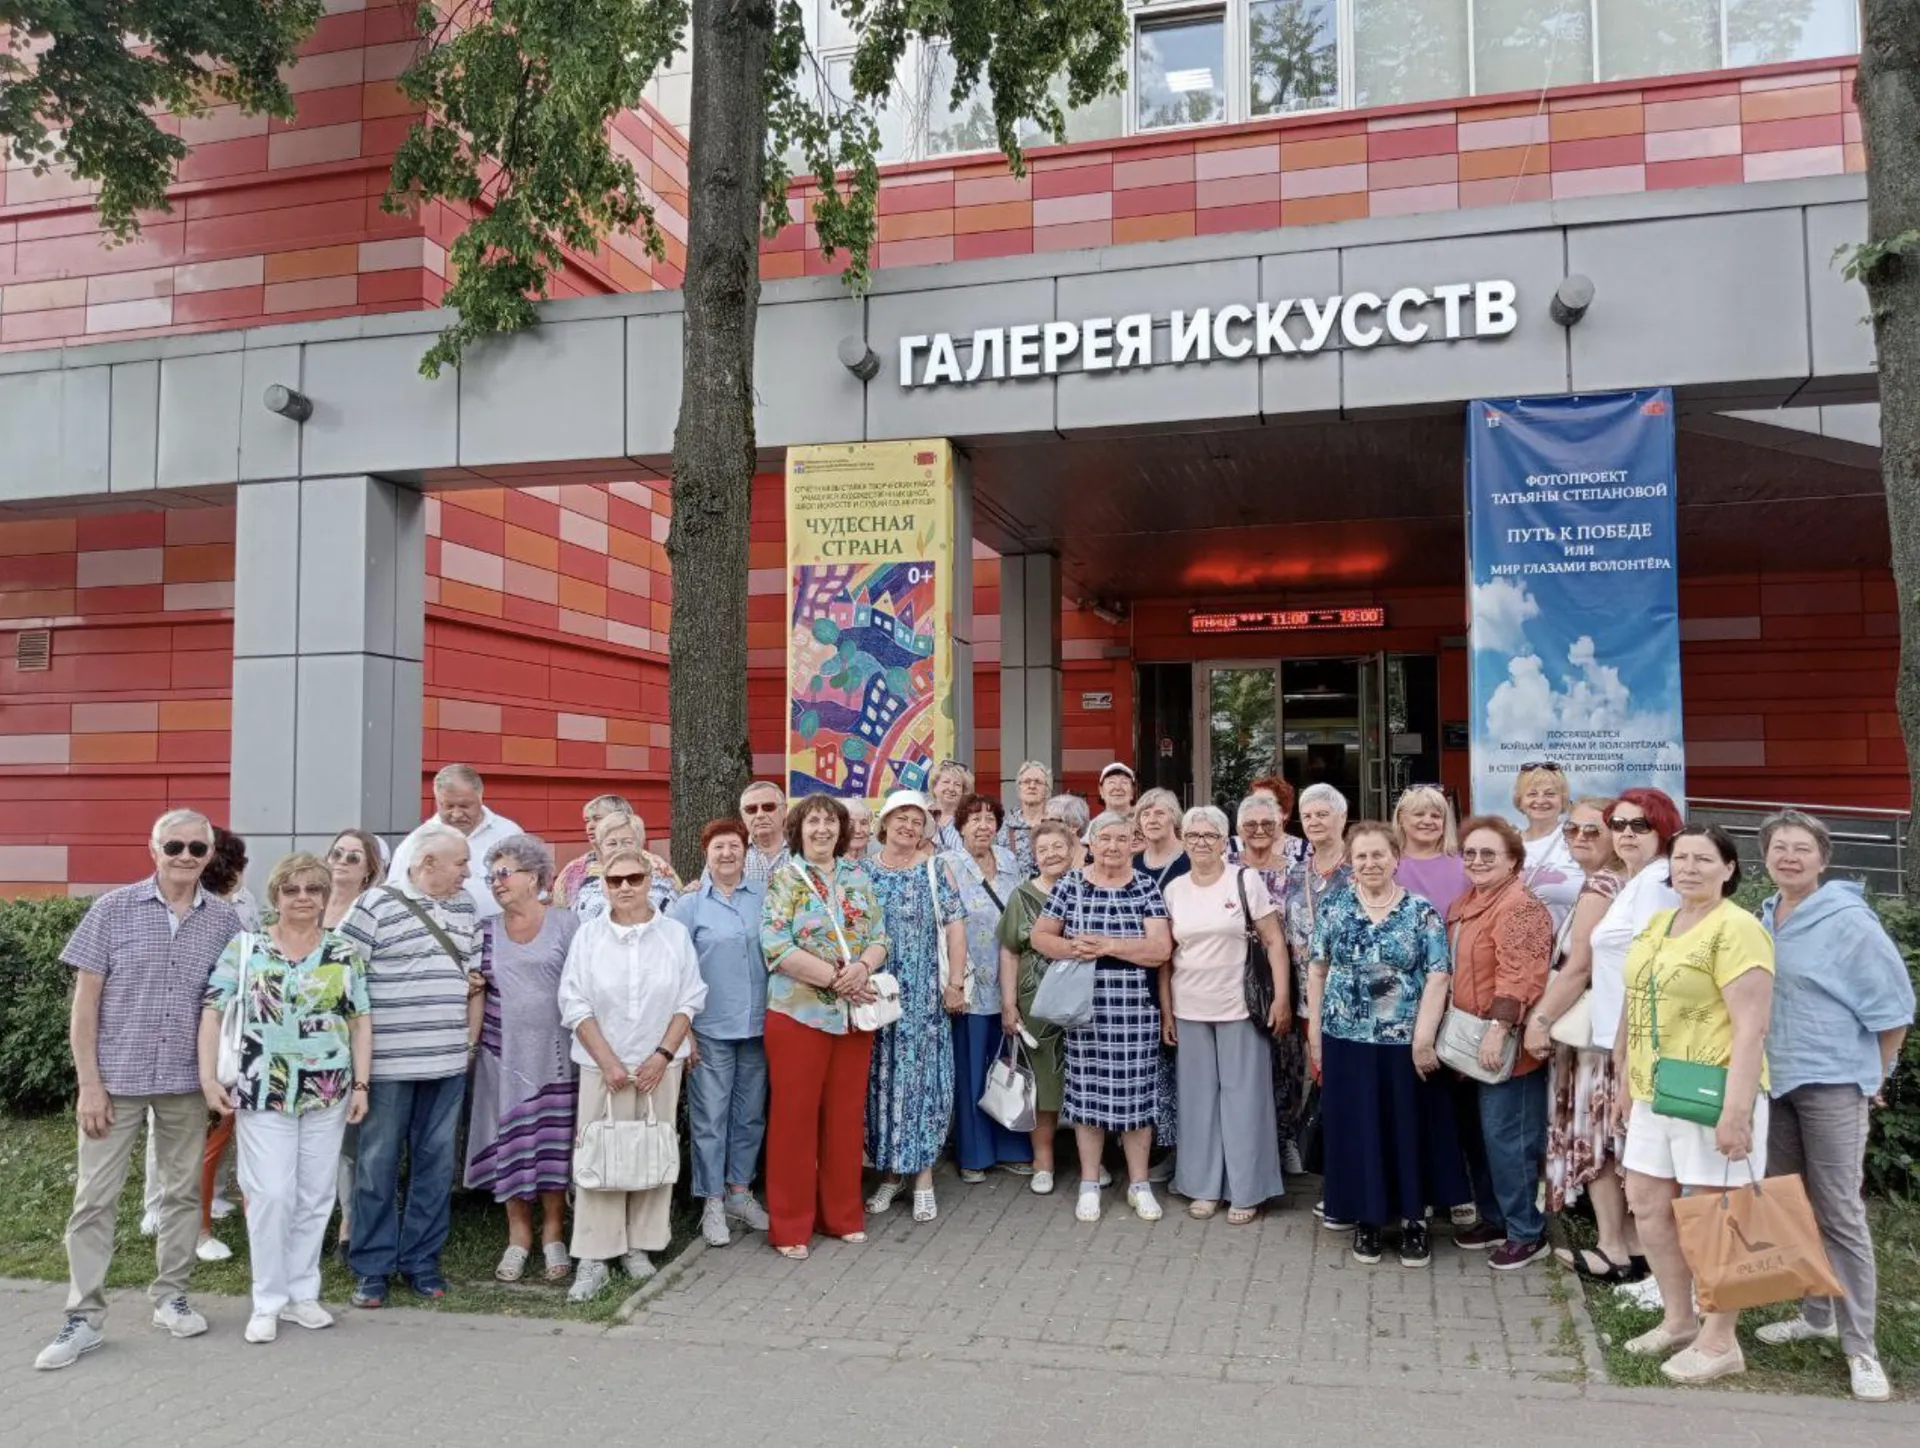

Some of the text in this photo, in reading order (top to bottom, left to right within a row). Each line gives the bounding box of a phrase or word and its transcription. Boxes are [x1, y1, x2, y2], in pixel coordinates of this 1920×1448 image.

[899, 278, 1518, 387] ГАЛЕРЕЯ ИСКУССТВ
[1526, 470, 1628, 487] ФОТОПРОЕКТ
[1491, 482, 1668, 505] ТАТЬЯНЫ СТЕПАНОВОЙ
[806, 514, 915, 538] ЧУДЕСНАЯ
[1507, 522, 1653, 544] ПУТЬ К ПОБЕДЕ
[822, 538, 904, 557] СТРАНА
[1563, 544, 1595, 557] ИЛИ
[1490, 556, 1672, 575] МИР ГЛАЗАМИ ВОЛОНТЁРА
[907, 567, 933, 584] 0+
[1271, 613, 1309, 626] 11:00
[1340, 608, 1378, 623] 19:00
[1626, 763, 1682, 773] ОПЕРАЦИИ
